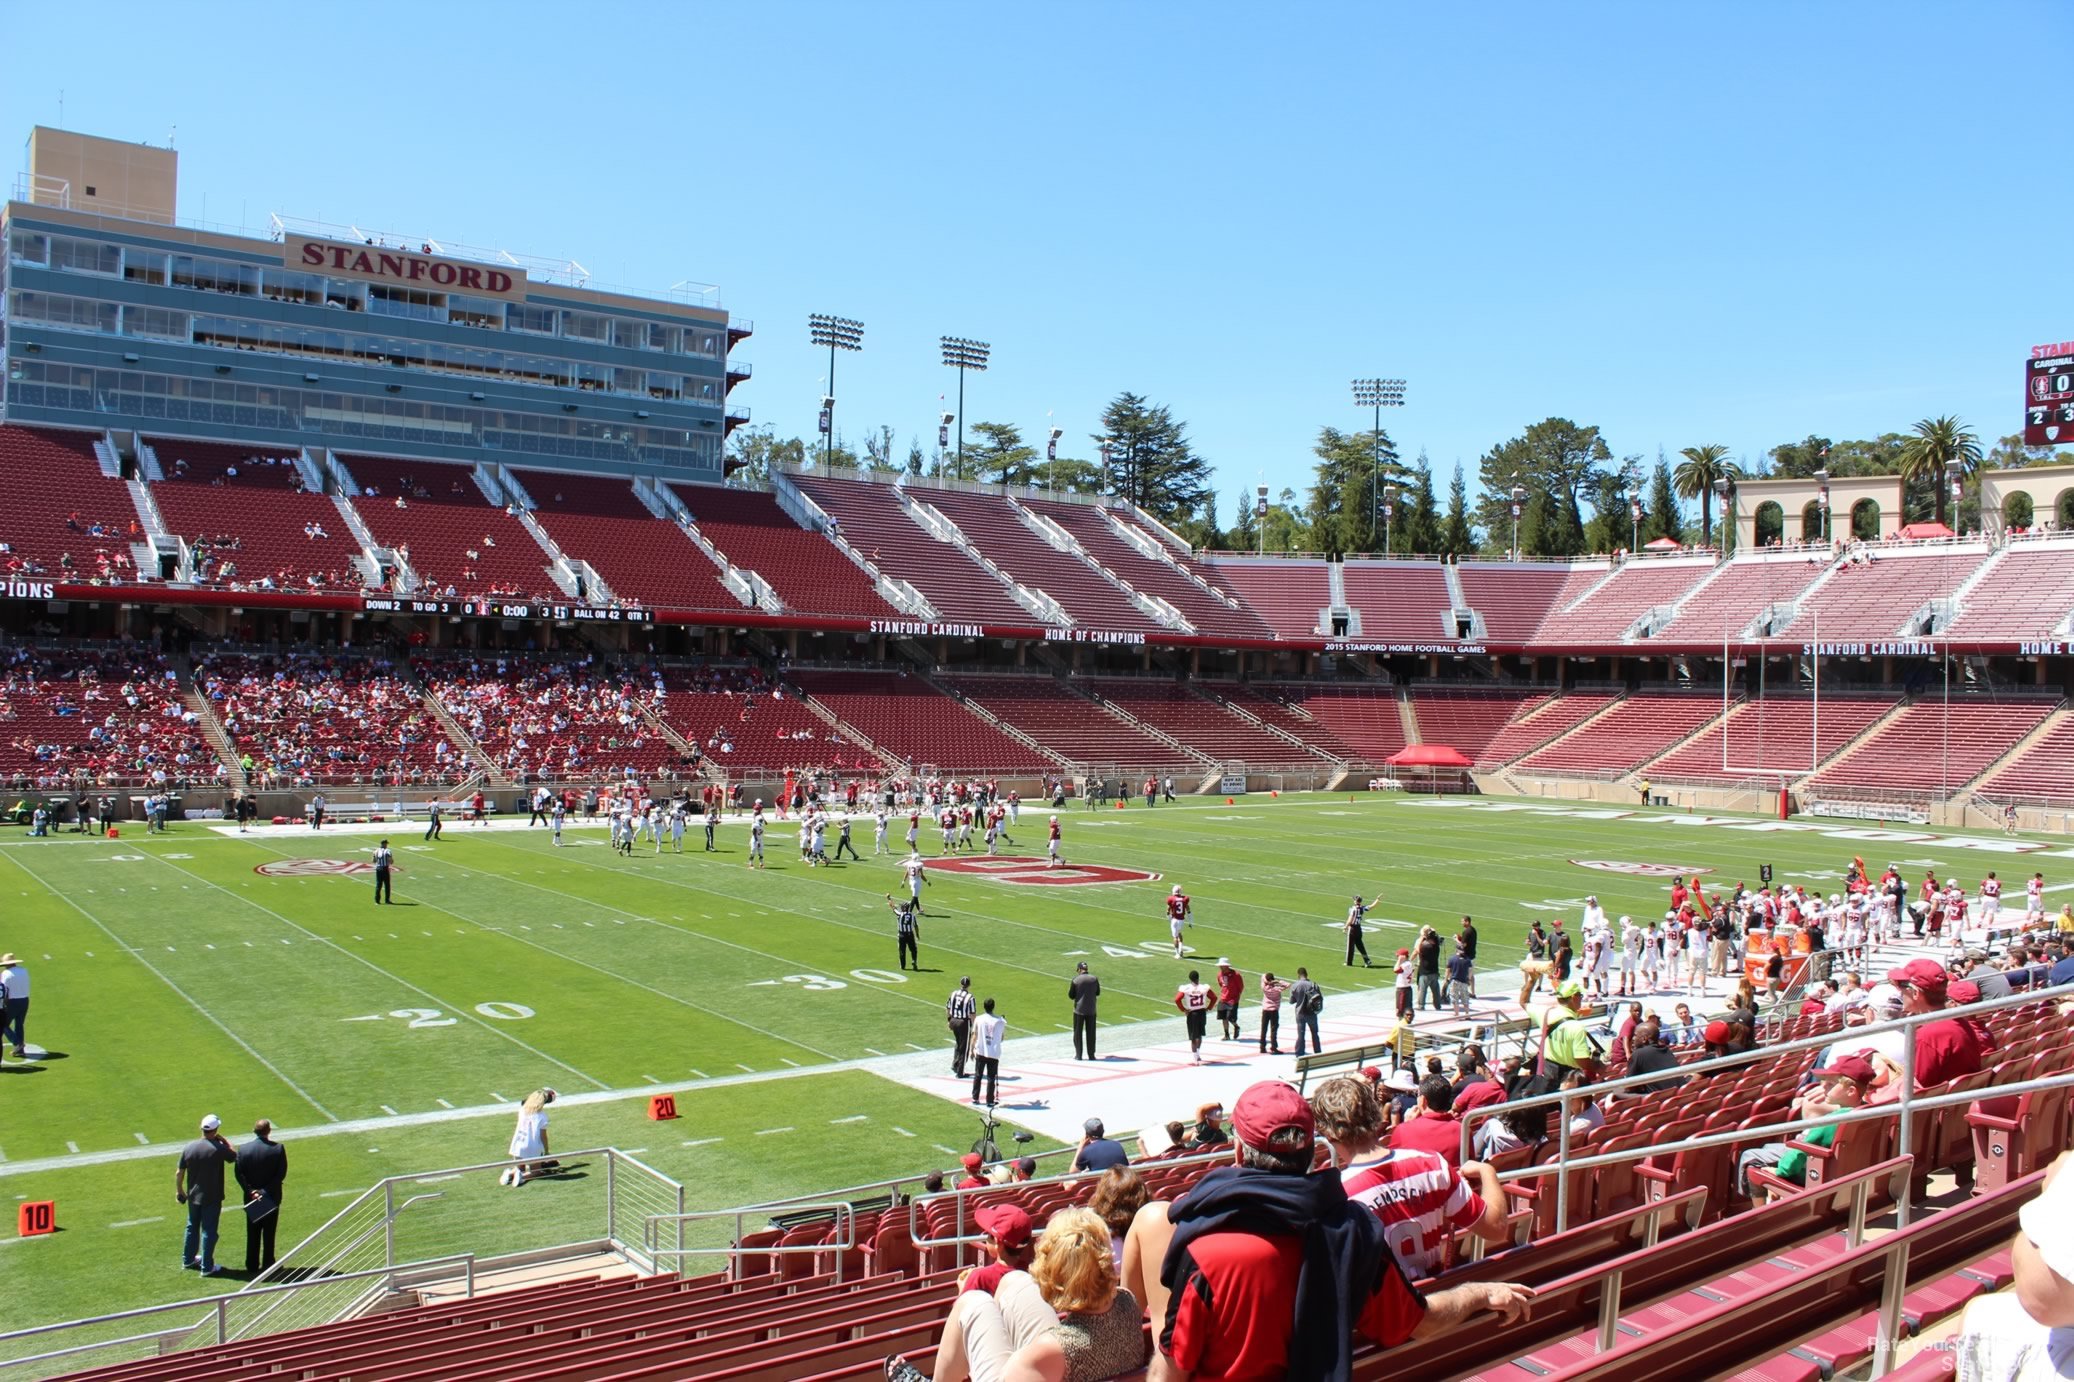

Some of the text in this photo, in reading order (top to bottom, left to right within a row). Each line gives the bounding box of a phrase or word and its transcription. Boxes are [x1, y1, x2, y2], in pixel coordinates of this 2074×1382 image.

[302, 243, 512, 292] STANFORD
[2031, 341, 2074, 359] STAN
[2057, 375, 2069, 392] 0
[2033, 409, 2074, 425] 2 3
[366, 600, 391, 610] DOWN
[394, 601, 400, 610] 2
[412, 602, 422, 611] TO
[425, 602, 437, 612] GO
[442, 603, 448, 613] 3
[465, 604, 472, 614] 0
[503, 605, 527, 617] 0:00
[542, 607, 549, 617] 3
[574, 609, 593, 618] BALL
[595, 610, 606, 619] ON
[608, 610, 619, 620] 42
[628, 611, 642, 620] QTR
[870, 621, 984, 637] STANFORD CARDINAL
[1045, 629, 1145, 644] HOME OF CHAMPIONS
[1325, 643, 1486, 654] 2015 STANFORD HOME FOOTBALL GAMES
[1803, 643, 1937, 655] STANFORD CARDINAL
[2020, 642, 2062, 655] HOME
[1176, 901, 1183, 914] 3
[782, 968, 908, 990] 30
[1190, 994, 1204, 1007] 21
[389, 1001, 536, 1029] 20
[655, 1097, 676, 1118] 20
[25, 1204, 49, 1232] 10
